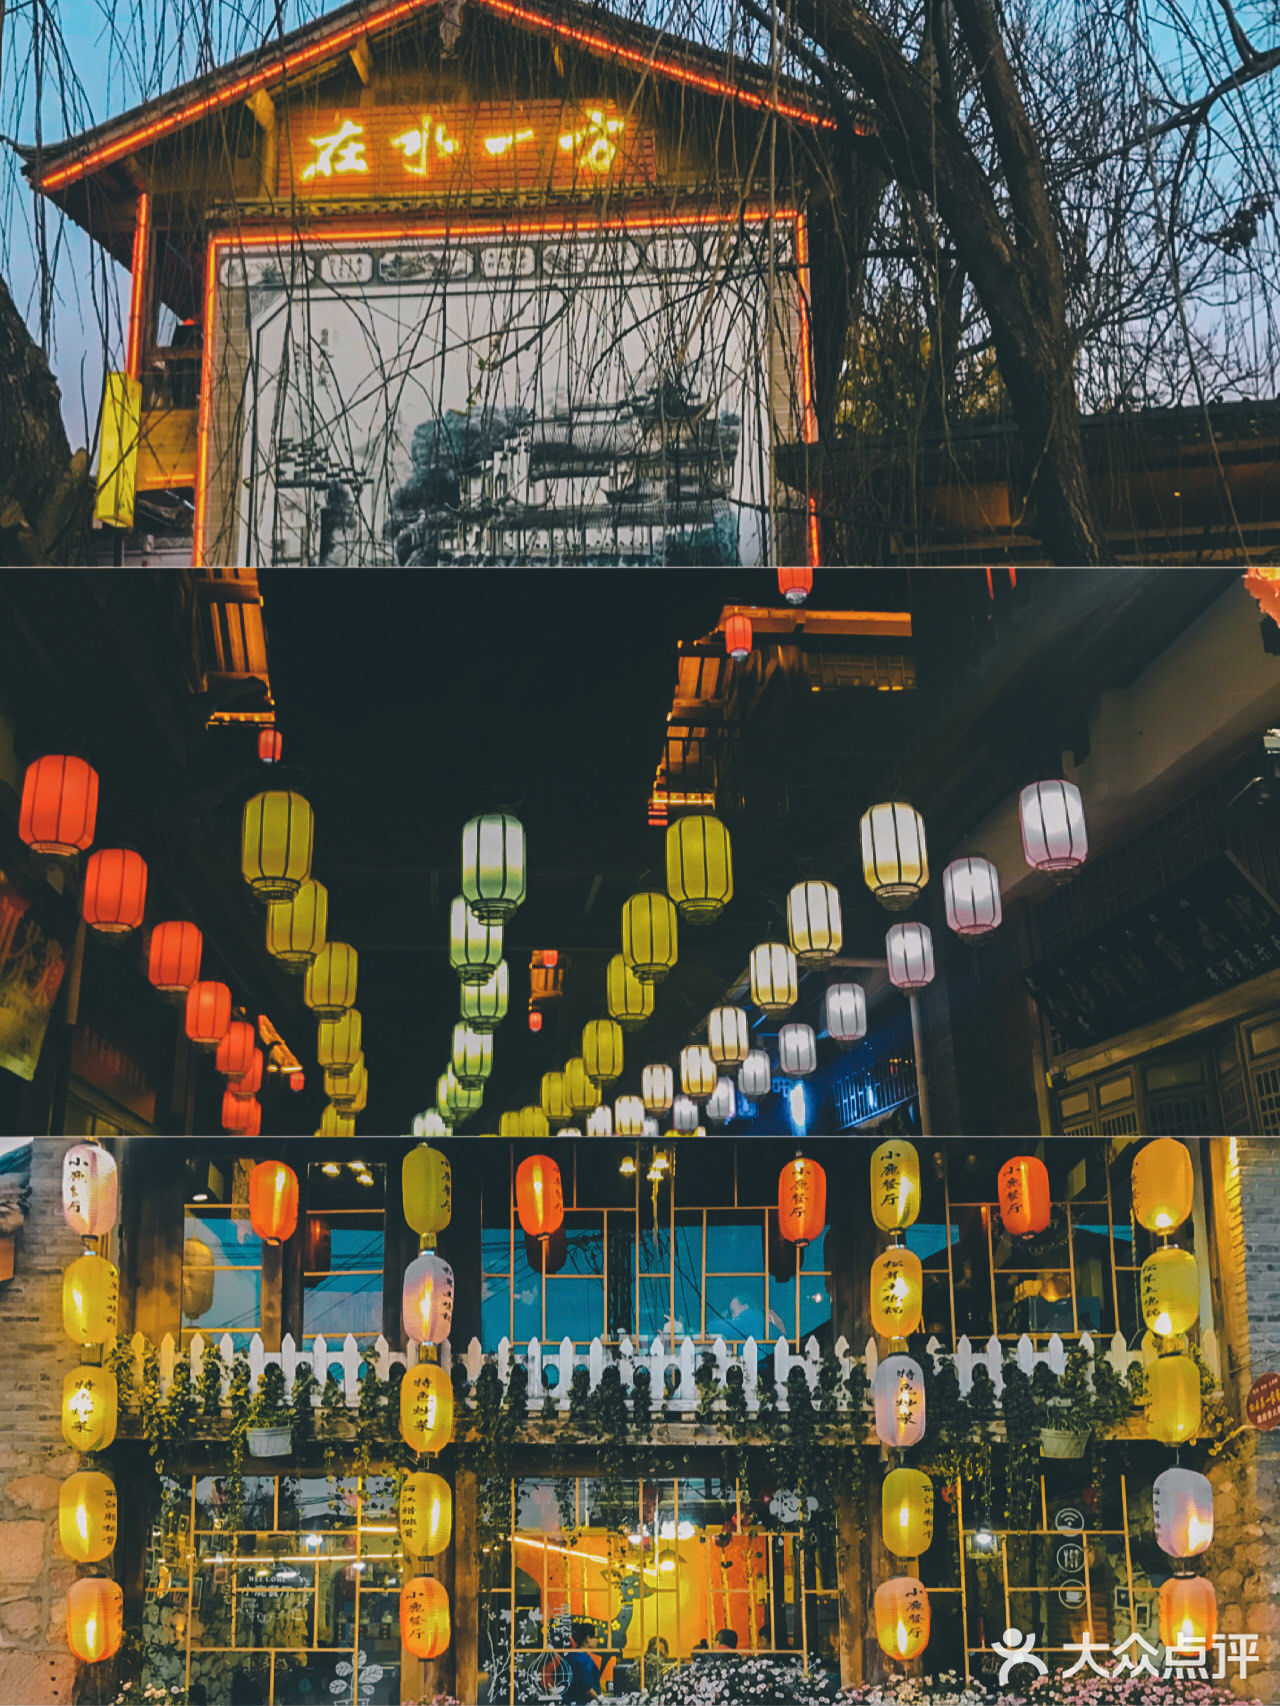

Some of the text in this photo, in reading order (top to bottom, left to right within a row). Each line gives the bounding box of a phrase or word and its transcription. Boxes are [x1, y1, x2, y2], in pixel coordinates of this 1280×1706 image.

[299, 109, 624, 182] 在水一方
[880, 1150, 902, 1207] 小鹿餐厅
[405, 1591, 426, 1641] 小鹿餐厅
